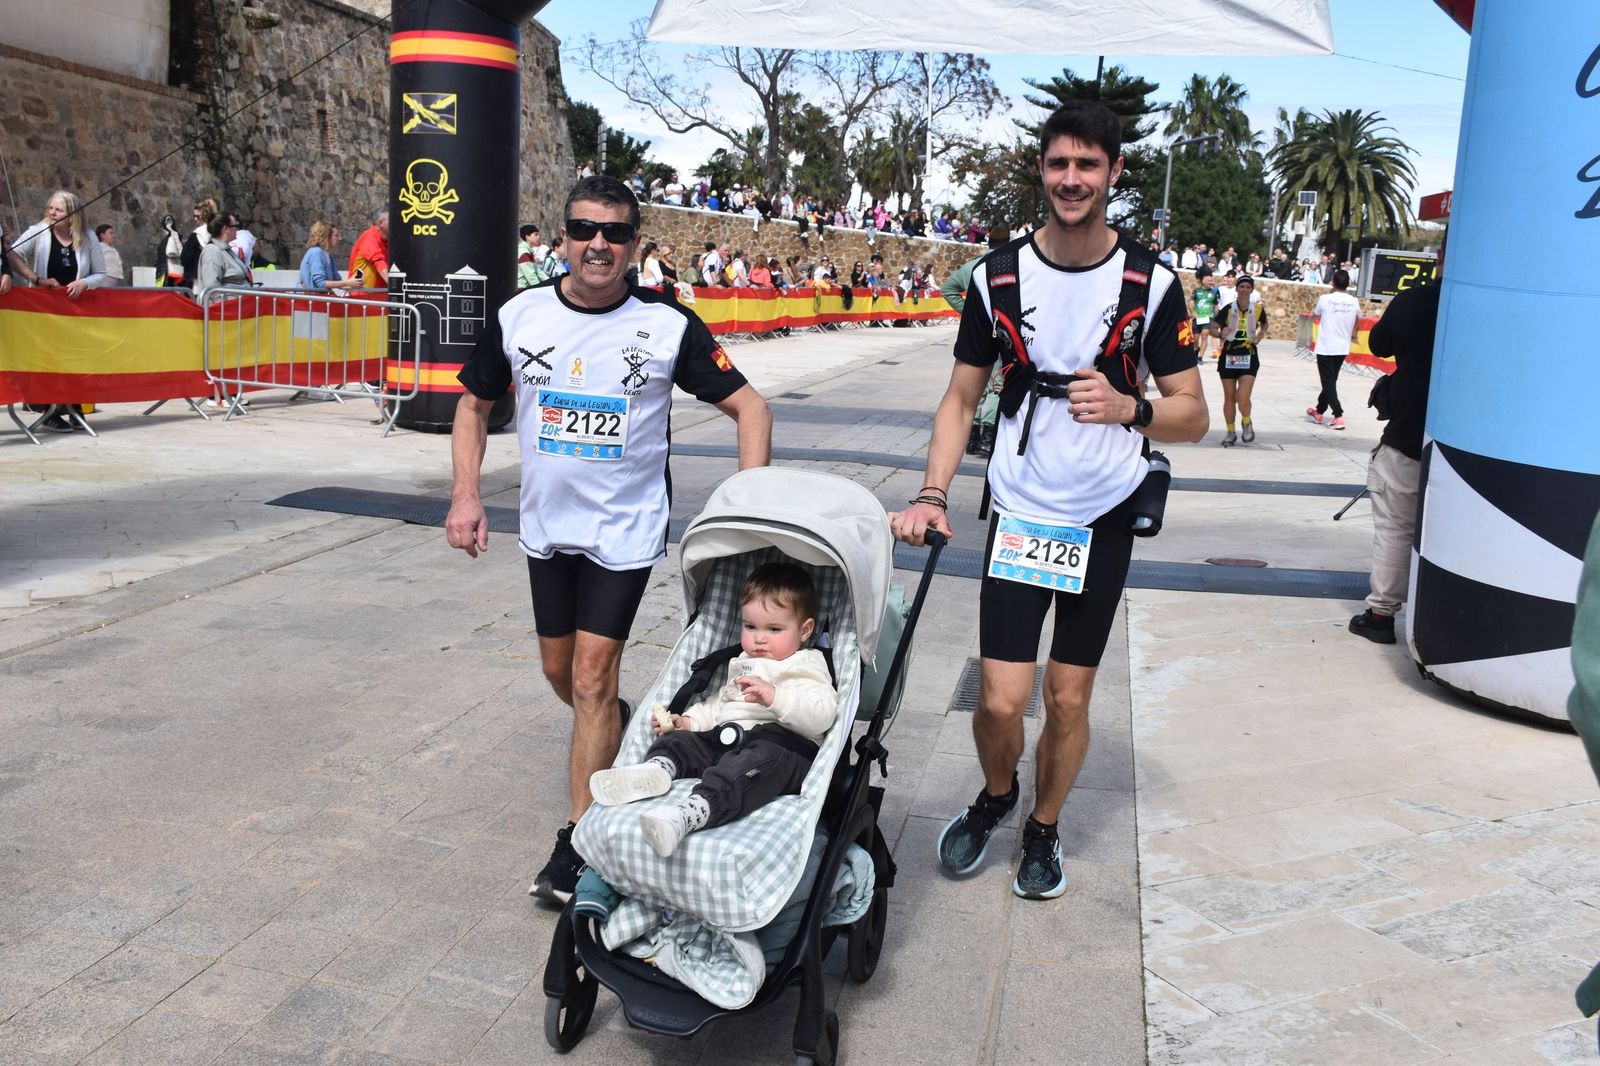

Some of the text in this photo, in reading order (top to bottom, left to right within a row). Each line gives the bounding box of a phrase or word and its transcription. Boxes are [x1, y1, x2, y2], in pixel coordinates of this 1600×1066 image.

[413, 224, 437, 236] DCC
[540, 424, 563, 437] 20K
[566, 410, 621, 437] 2122
[998, 547, 1023, 562] 20K
[1025, 538, 1081, 568] 2126
